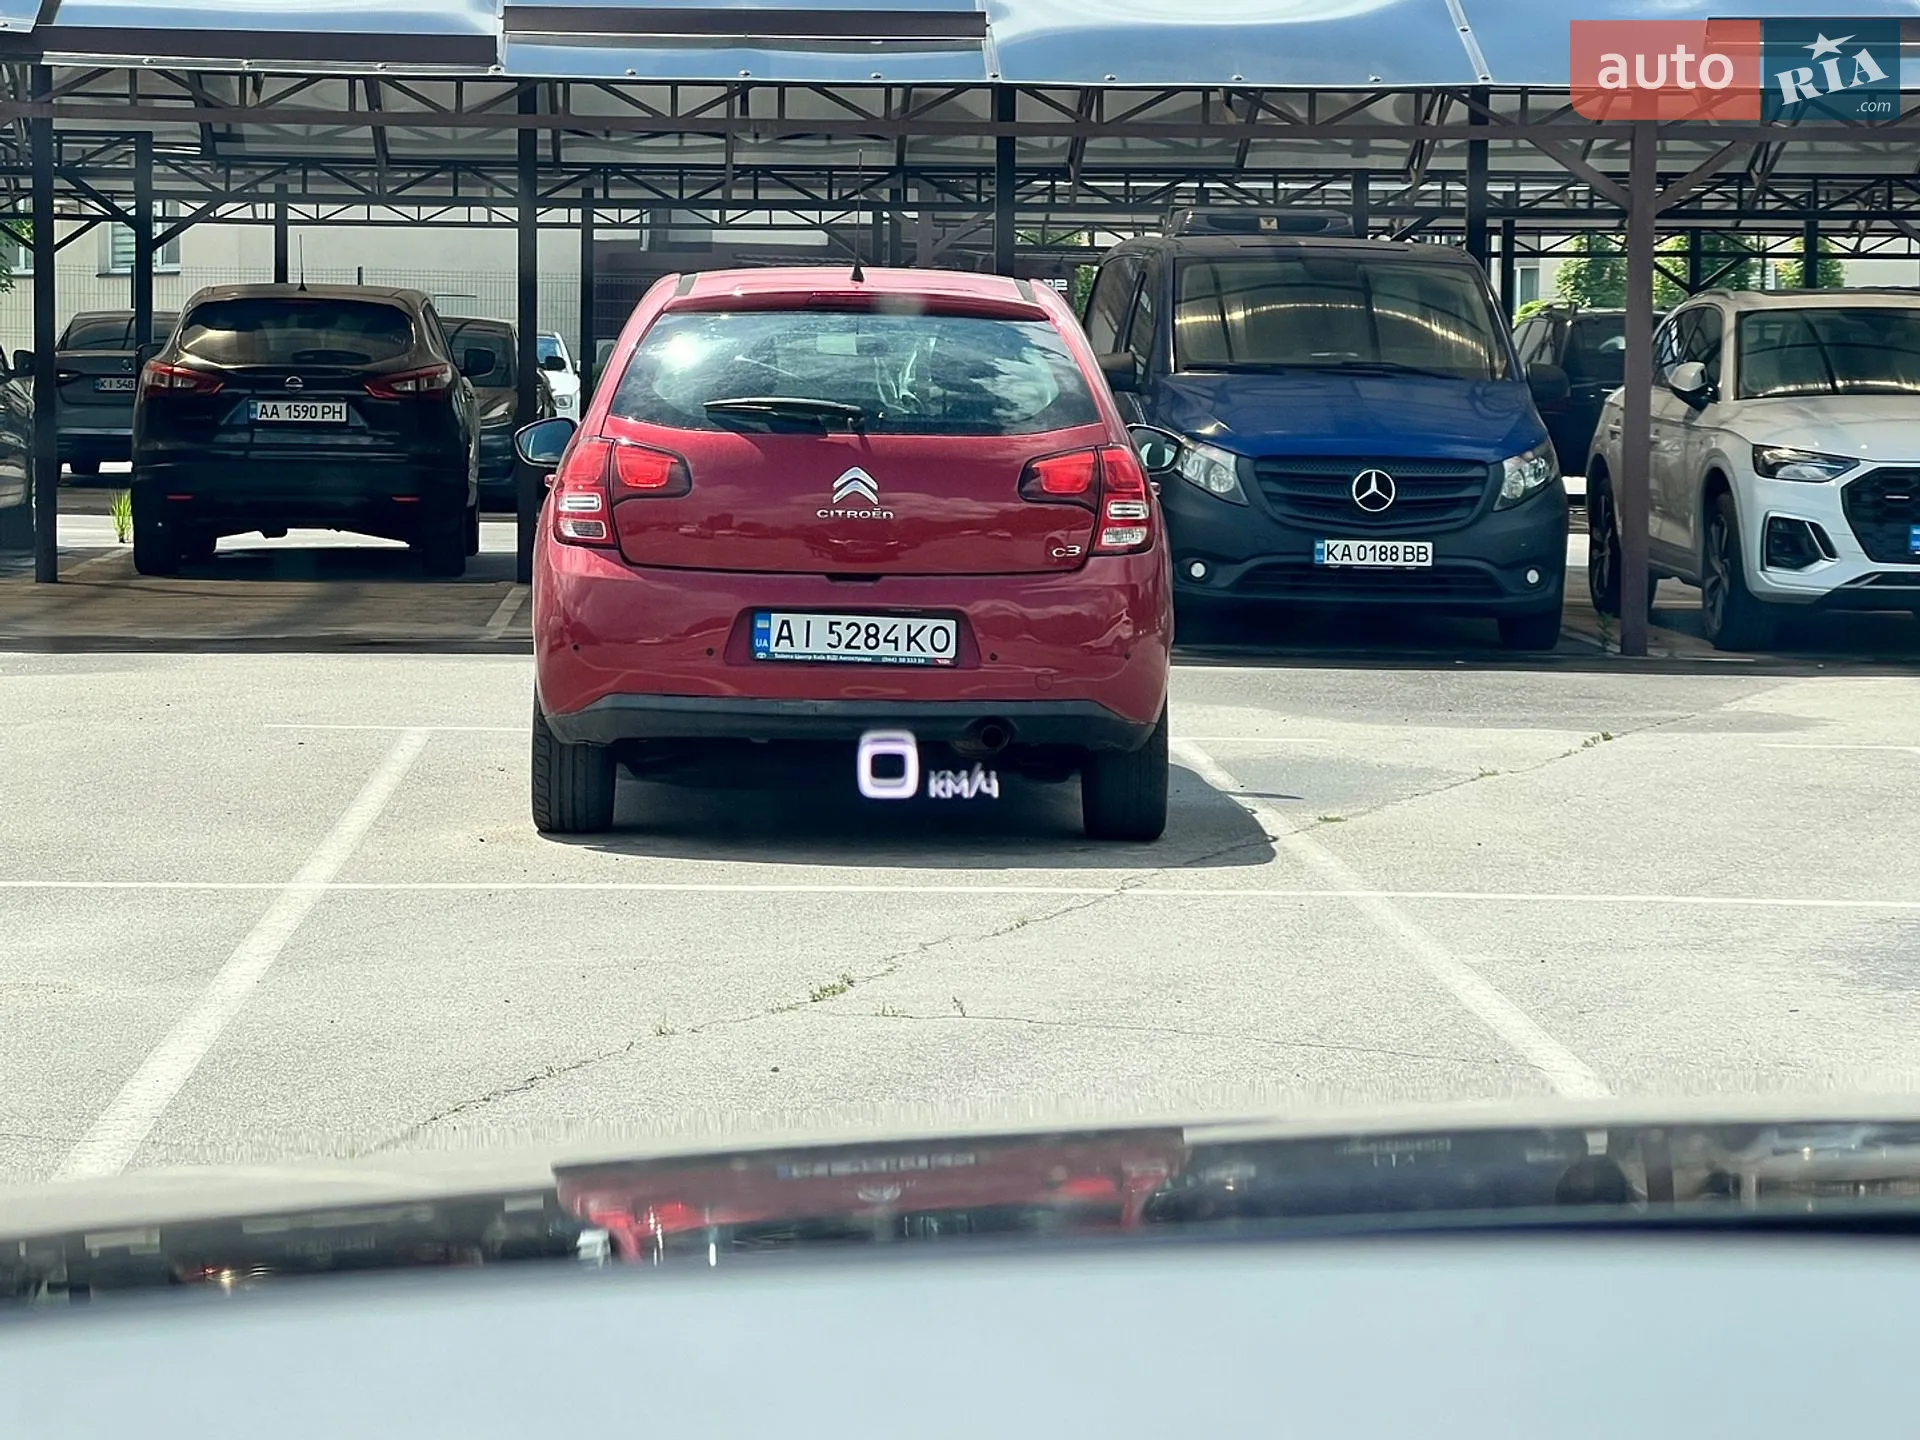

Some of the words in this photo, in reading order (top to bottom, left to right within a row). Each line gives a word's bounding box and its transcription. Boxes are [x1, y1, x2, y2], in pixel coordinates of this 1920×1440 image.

[259, 404, 280, 419] AA
[285, 404, 318, 419] 1590
[321, 405, 343, 420] PH
[1052, 545, 1081, 557] C3
[1326, 543, 1353, 561] KA
[1403, 545, 1429, 562] BB
[774, 619, 811, 648] AI
[755, 638, 769, 648] UA
[857, 729, 919, 799] 0
